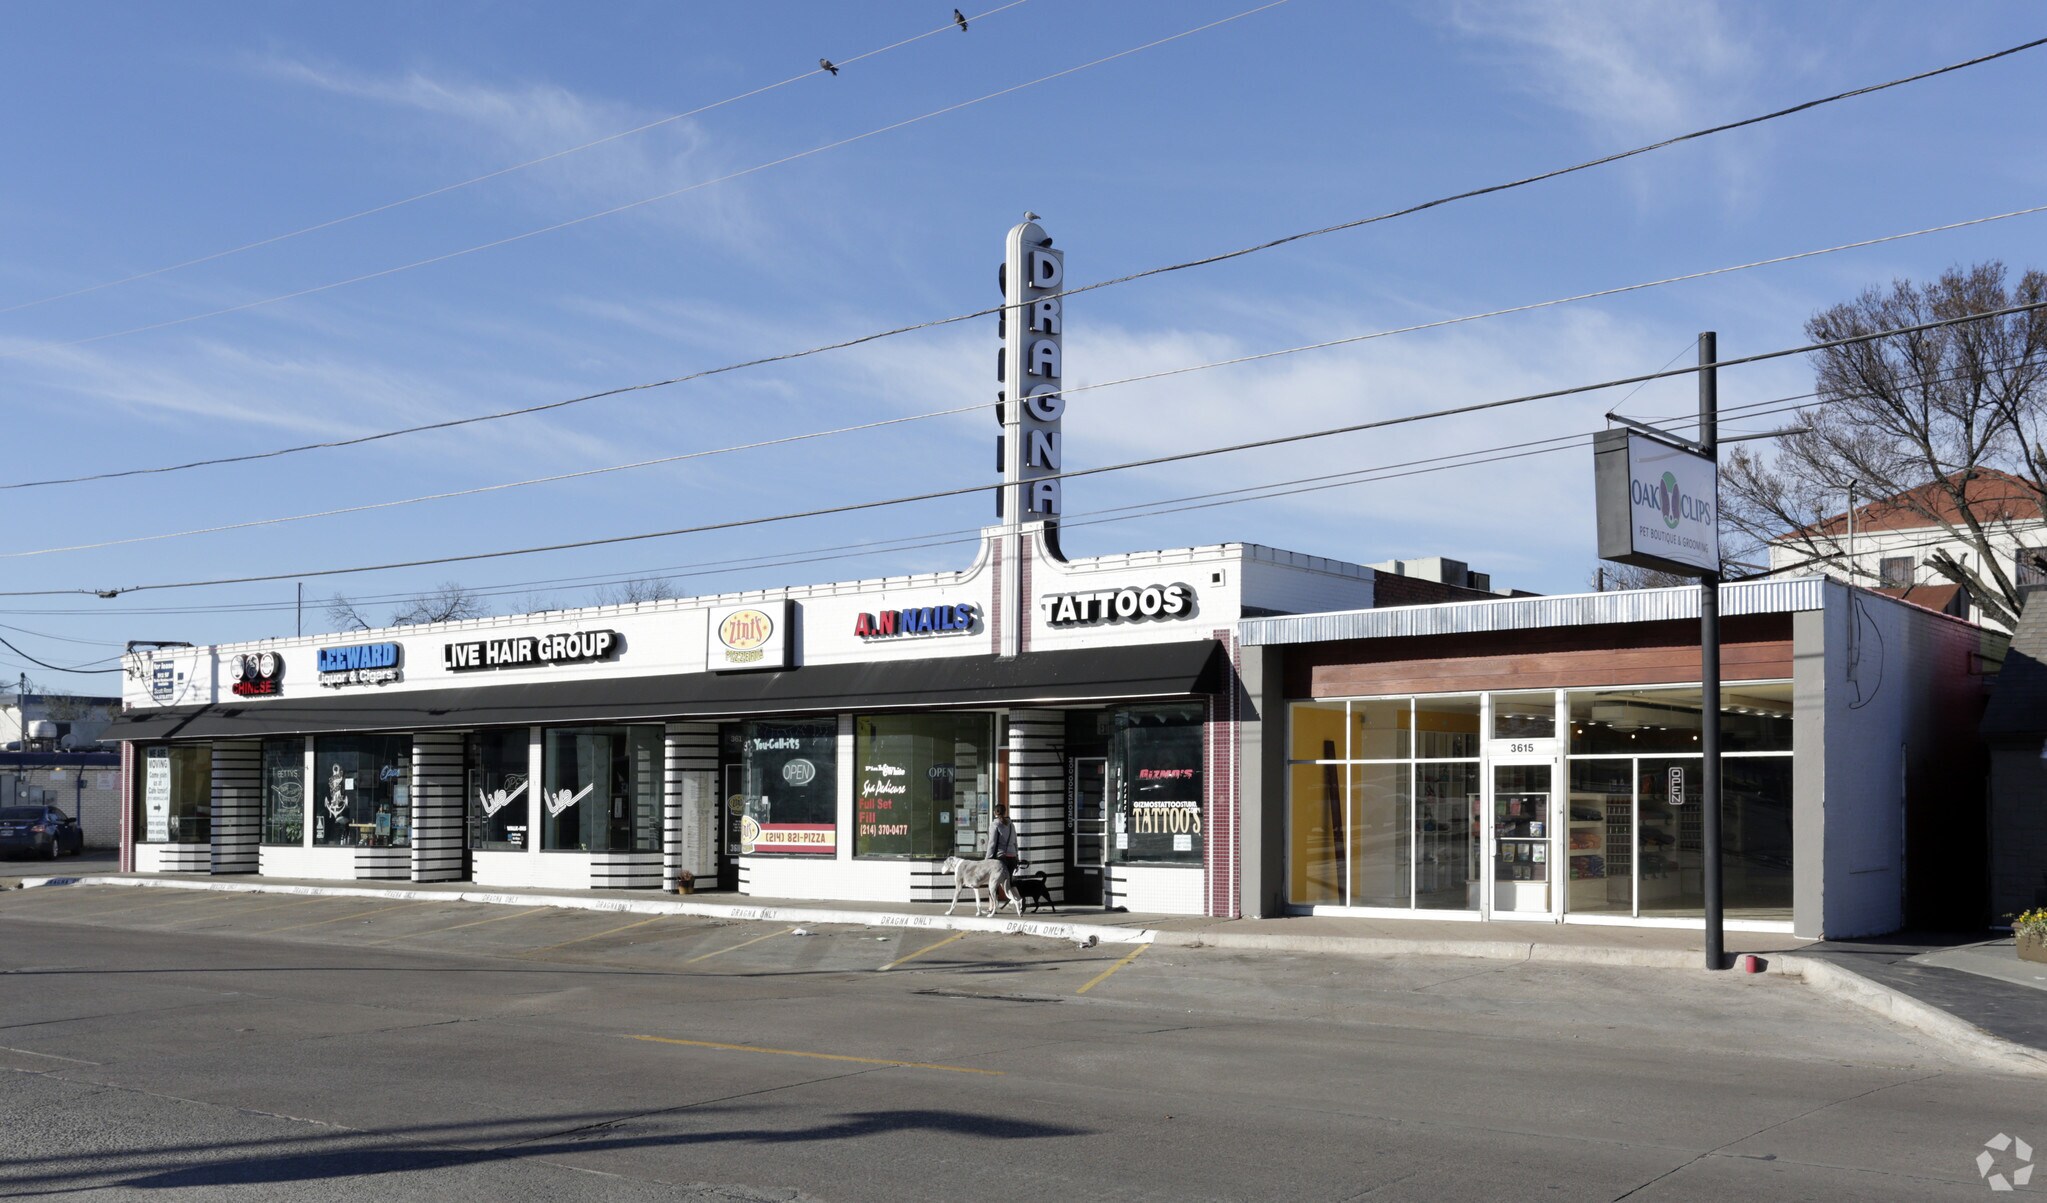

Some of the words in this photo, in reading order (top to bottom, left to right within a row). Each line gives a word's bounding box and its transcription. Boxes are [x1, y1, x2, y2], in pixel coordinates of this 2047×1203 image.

[1029, 250, 1065, 515] DRAGNA
[1631, 479, 1661, 511] OAK
[1681, 494, 1711, 526] CLIPS
[1639, 525, 1649, 537] PET
[1650, 528, 1677, 545] BOUTIQUE
[1677, 536, 1682, 546] &
[1682, 536, 1709, 553] GROOMING
[1040, 585, 1184, 623] TATTOOS
[901, 603, 970, 633] NAILS
[317, 643, 397, 672] LEEWARD
[442, 643, 480, 668] LIVE
[486, 638, 532, 665] HAIR
[537, 632, 610, 661] GROUP
[318, 671, 347, 685] Liquor
[350, 670, 357, 682] &
[359, 669, 393, 685] Cigars
[232, 680, 274, 695] CHINESE
[1510, 743, 1534, 752] 3615
[783, 764, 810, 780] OPEN
[928, 766, 954, 778] OPEN
[874, 779, 906, 797] Pedicure
[1671, 769, 1681, 803] OPEN
[858, 798, 875, 810] Full
[877, 798, 893, 810] Set
[858, 811, 877, 823] Fill
[765, 832, 785, 843] (214)
[787, 832, 826, 843] 821-PIZZA
[860, 824, 877, 837] (214)
[878, 824, 908, 836] 370-0477
[731, 908, 756, 918] DRAGNA
[880, 916, 909, 926] DRAGNA
[913, 916, 932, 926] ONLY
[1006, 922, 1038, 933] DRAGNA
[1043, 926, 1066, 936] ONLY
